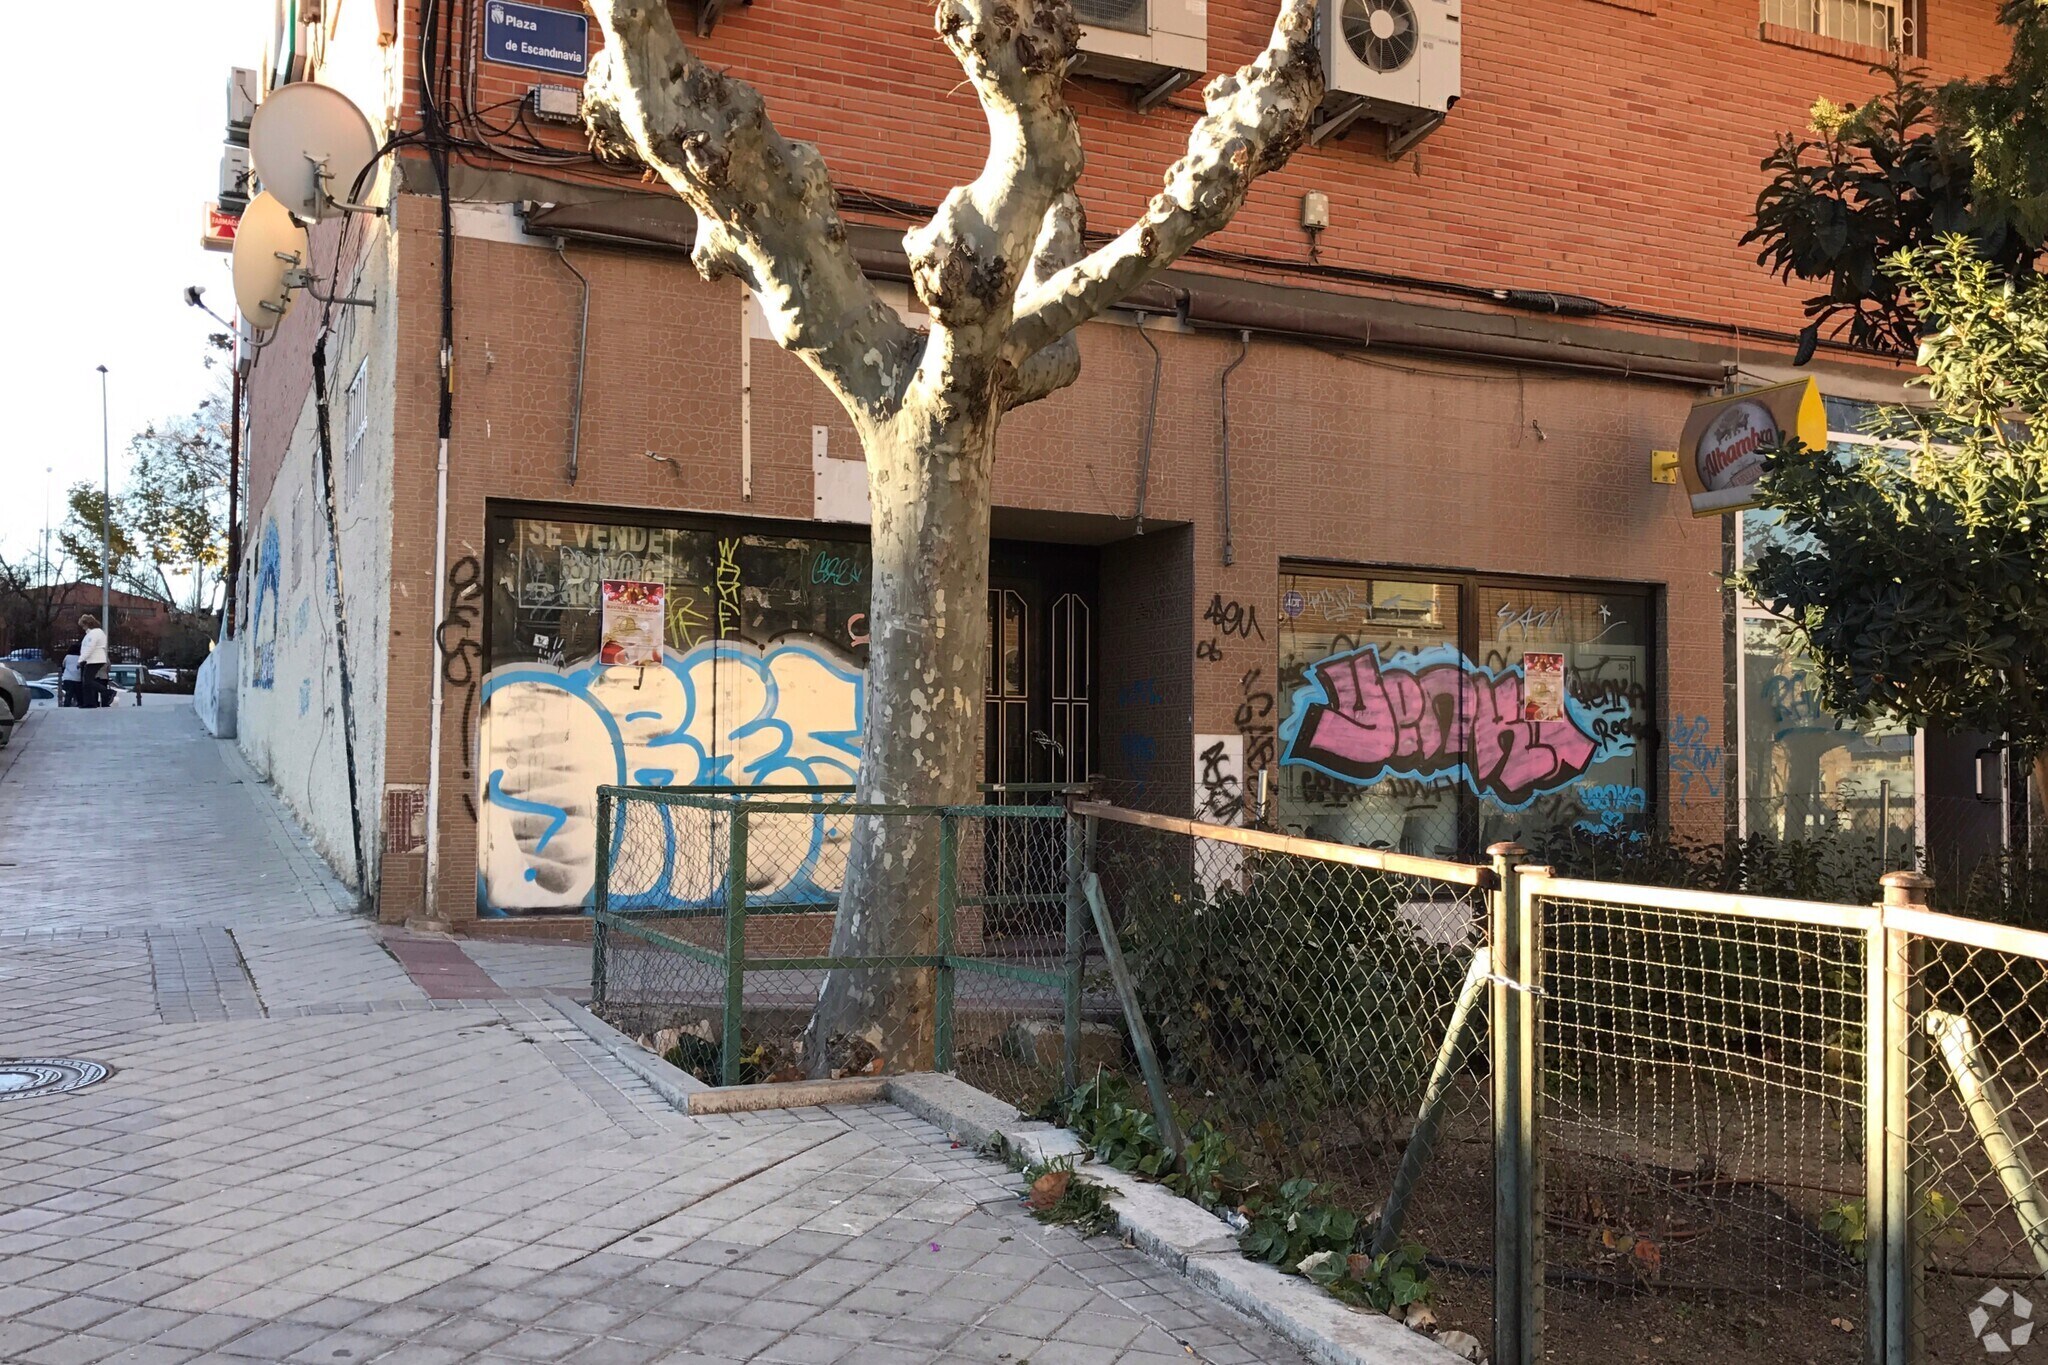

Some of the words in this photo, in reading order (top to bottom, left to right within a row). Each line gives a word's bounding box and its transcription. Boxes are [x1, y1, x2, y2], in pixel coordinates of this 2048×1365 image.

[505, 14, 537, 31] Plaza
[505, 39, 518, 51] de
[521, 41, 582, 63] Escandinavia
[211, 216, 239, 227] FARMAC
[1703, 426, 1775, 487] Alhambra
[528, 520, 562, 547] SE
[573, 523, 664, 553] VENDE
